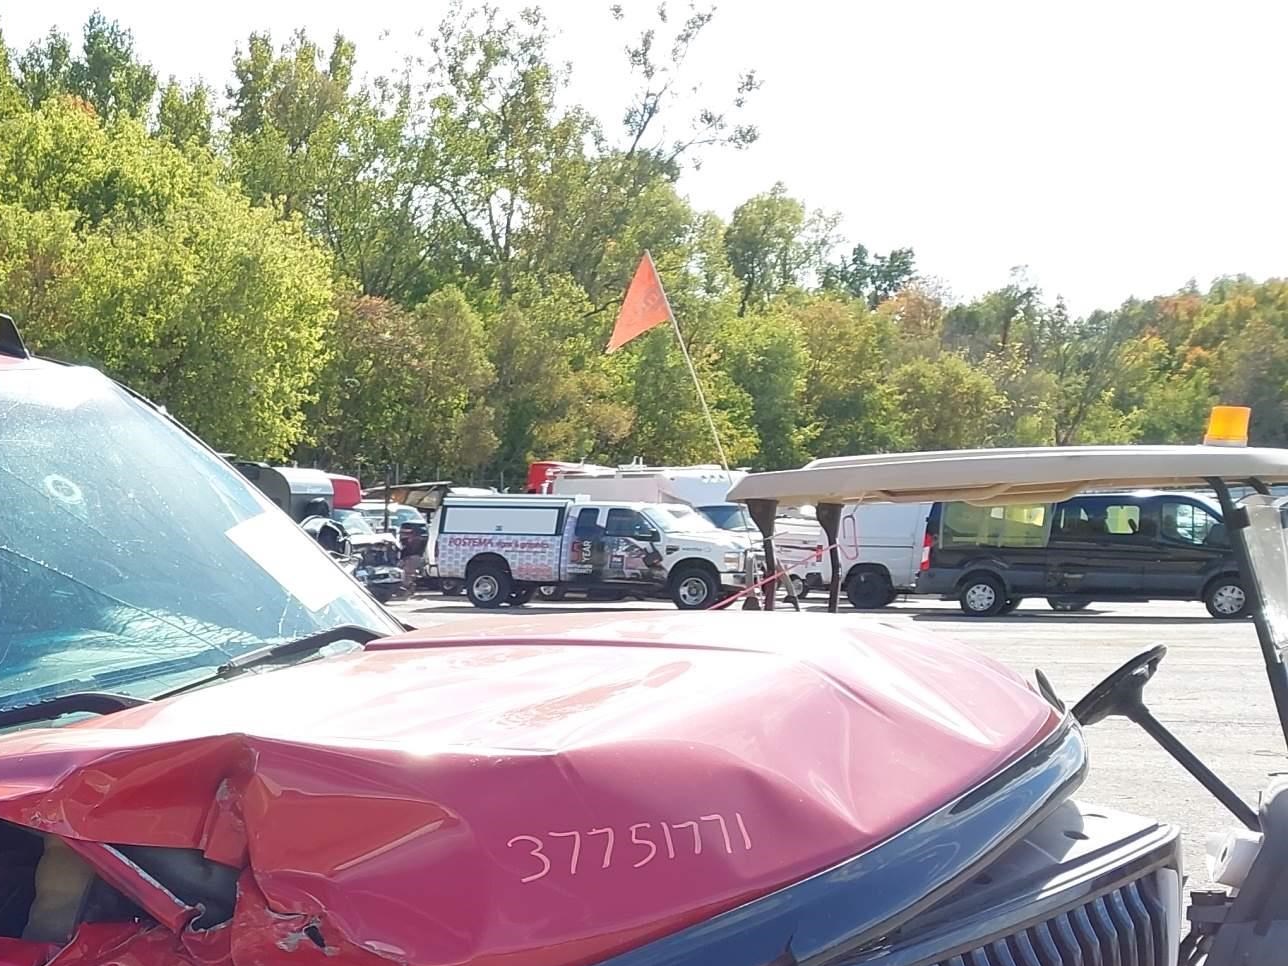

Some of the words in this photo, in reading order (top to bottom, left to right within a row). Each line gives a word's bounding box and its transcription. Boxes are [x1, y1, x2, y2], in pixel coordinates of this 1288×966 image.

[448, 537, 494, 547] POSTEMA
[582, 540, 592, 562] YEAR
[507, 812, 752, 883] 37751771
